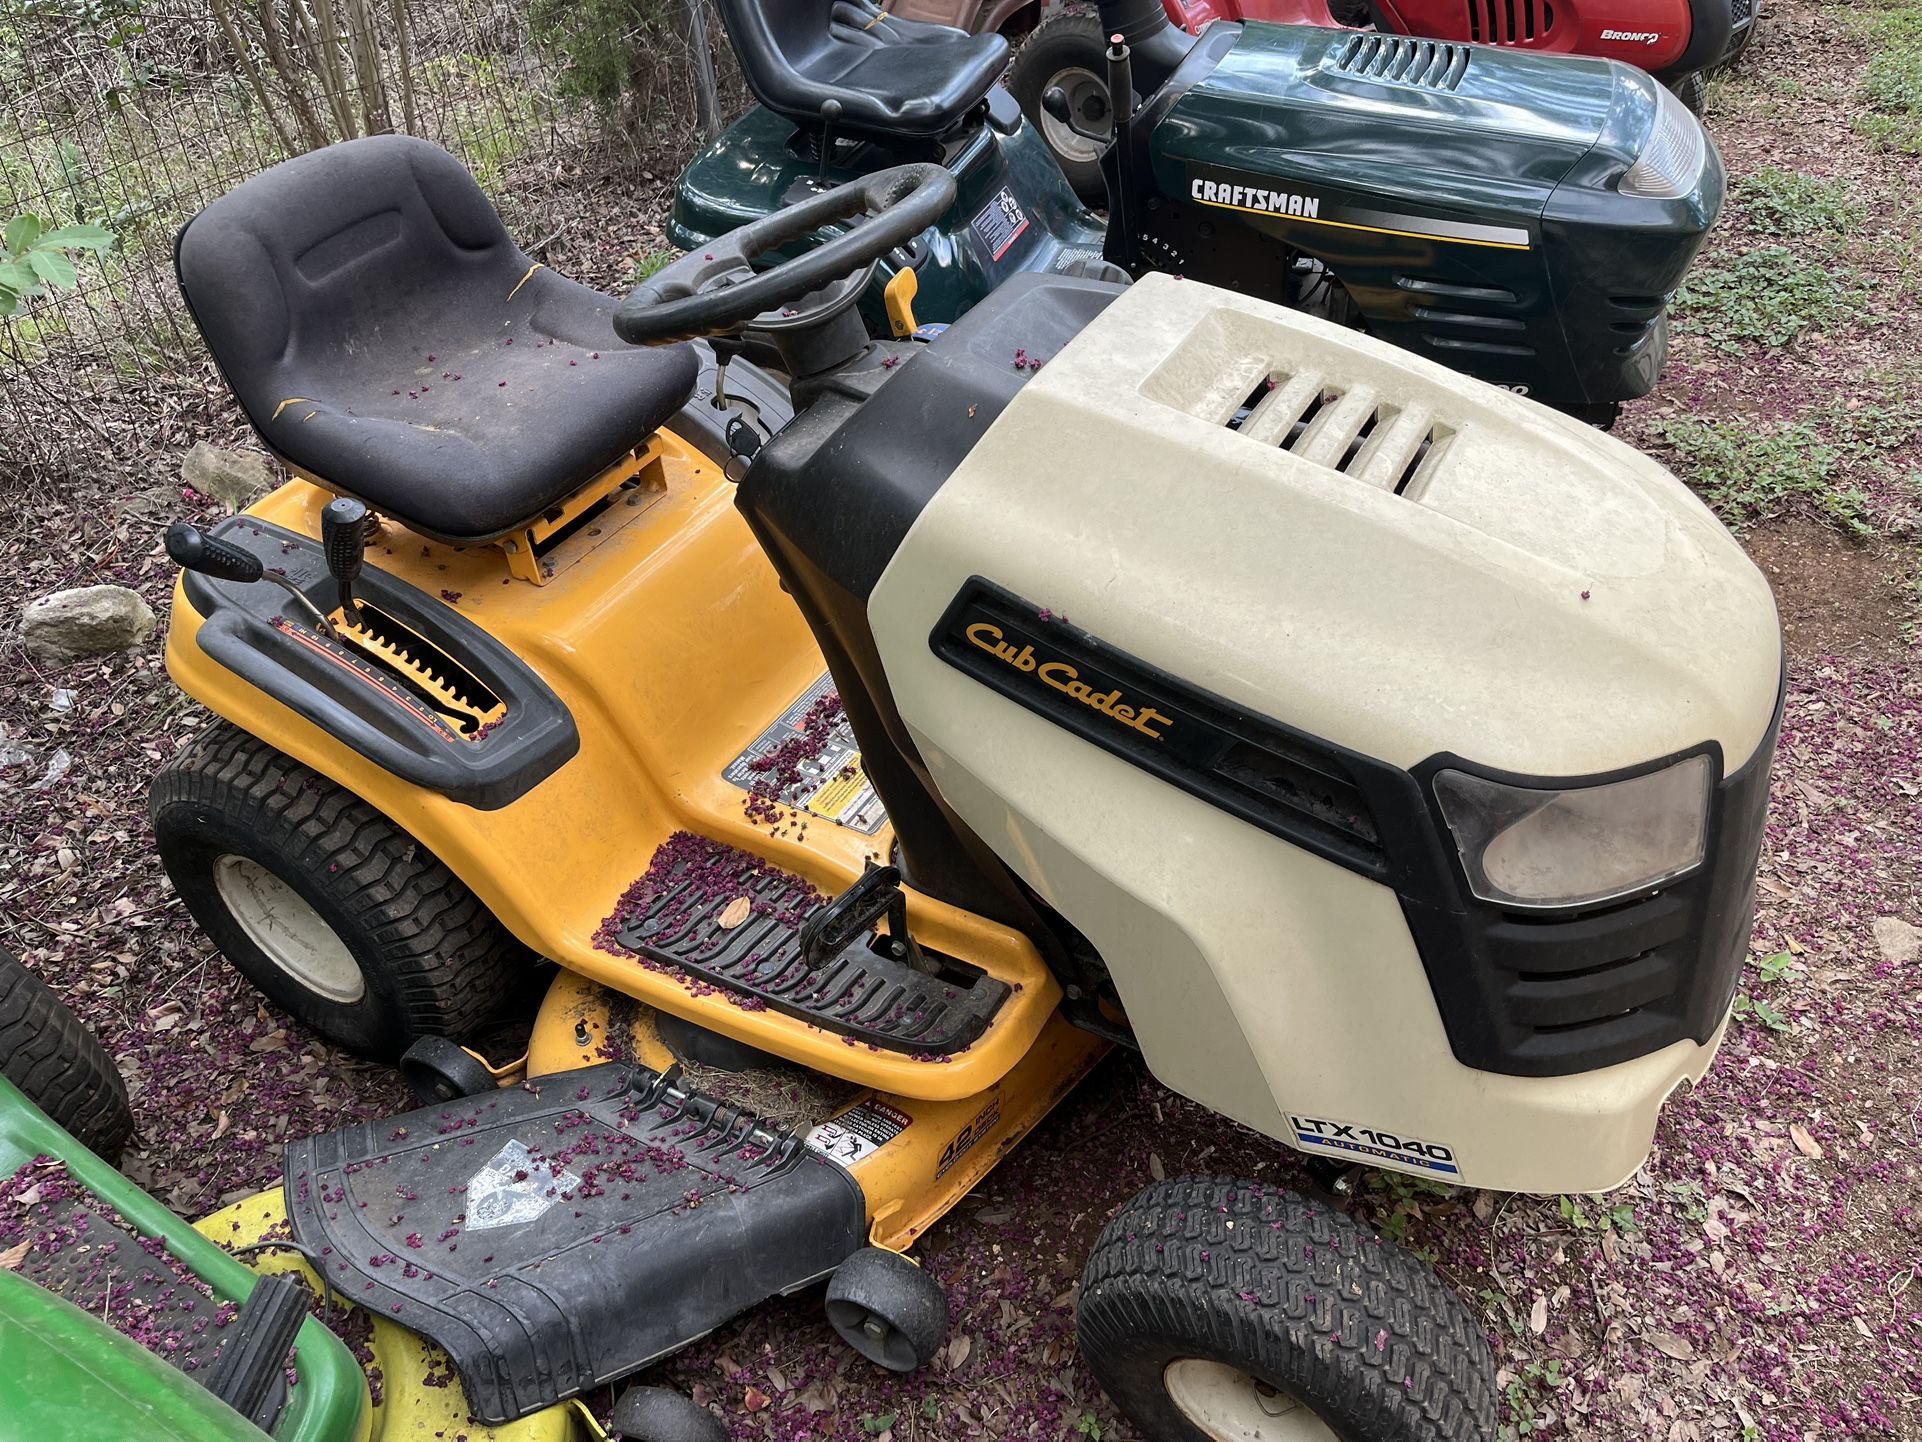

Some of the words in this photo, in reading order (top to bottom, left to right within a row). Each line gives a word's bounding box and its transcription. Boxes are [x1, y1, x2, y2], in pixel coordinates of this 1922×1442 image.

[1600, 29, 1659, 45] BRONCO
[1191, 178, 1320, 219] CRAFTSMAN
[965, 622, 1037, 672] Cub
[1037, 662, 1174, 739] Cadet
[873, 1103, 908, 1126] DANGER
[938, 1124, 973, 1168] 42
[975, 1098, 999, 1125] INCH
[1321, 1138, 1431, 1167] AUTOMATIC
